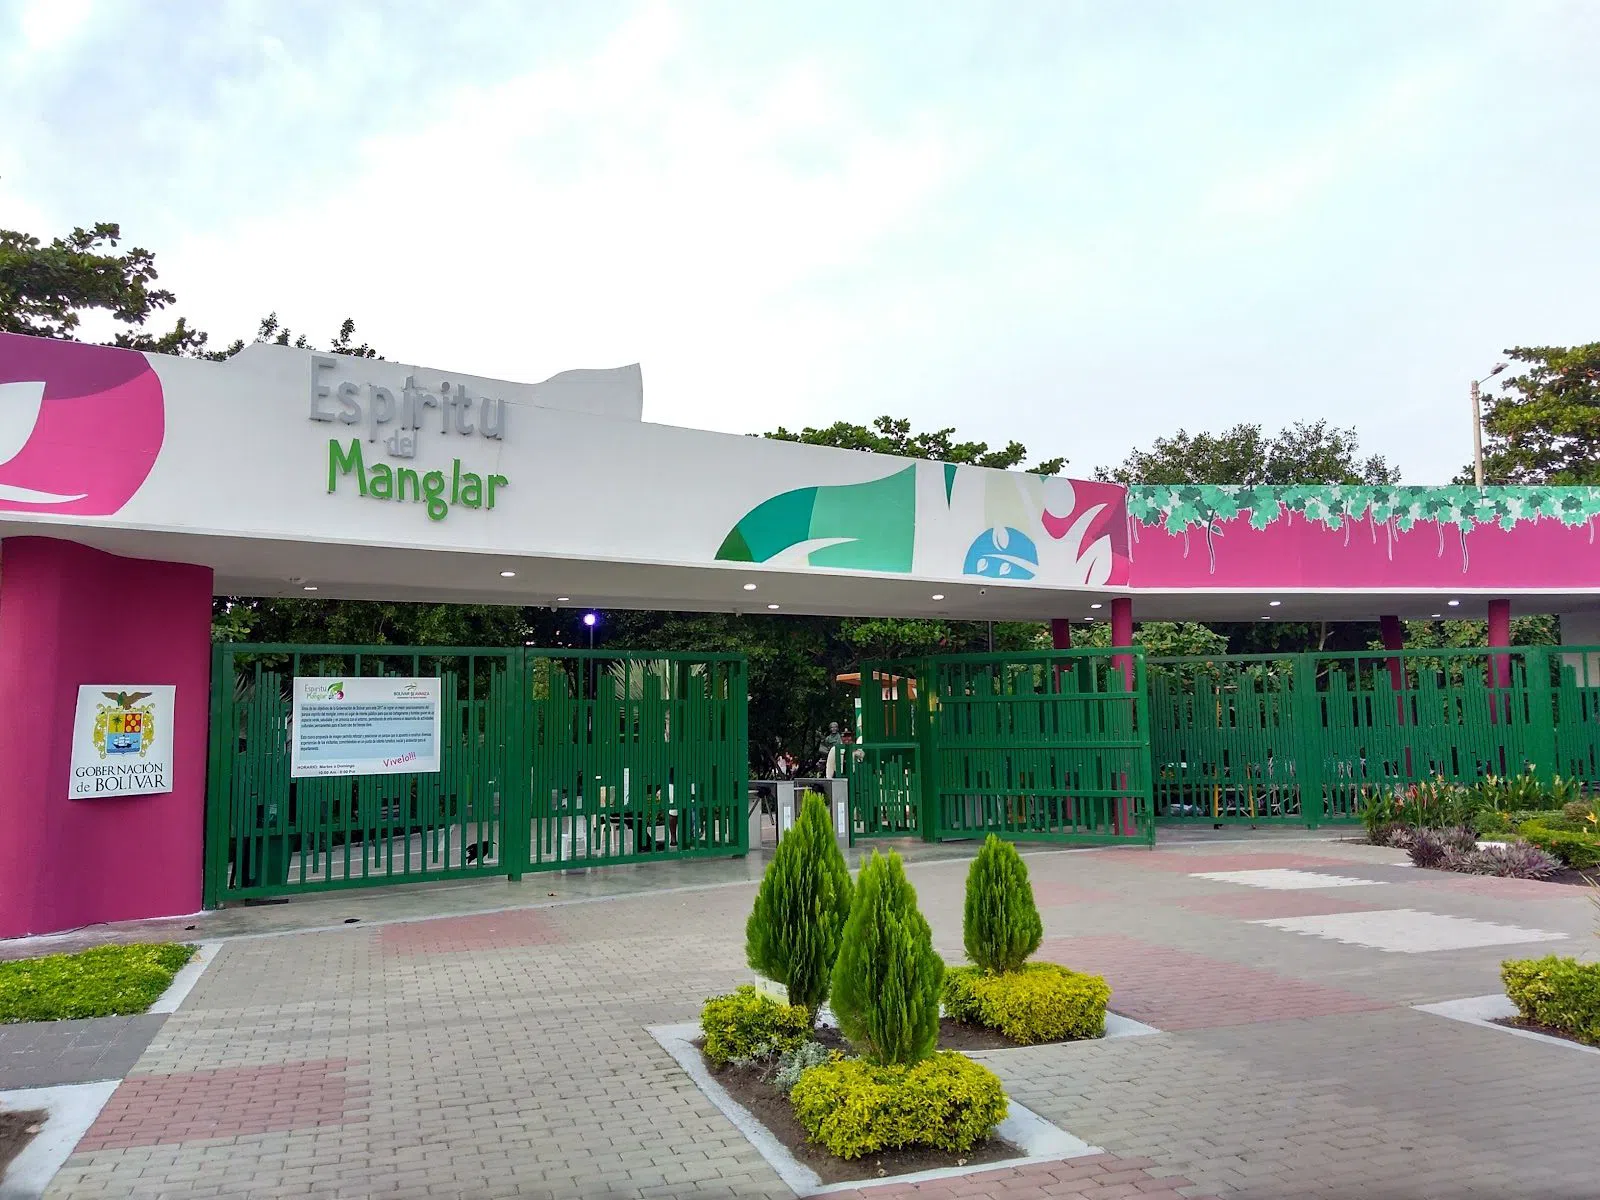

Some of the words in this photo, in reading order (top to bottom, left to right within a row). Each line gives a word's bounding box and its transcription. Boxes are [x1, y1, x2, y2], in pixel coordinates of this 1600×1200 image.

[386, 429, 417, 459] del
[327, 438, 509, 521] Manglar
[75, 762, 163, 778] GOBERNACIÓN
[76, 782, 90, 793] de
[96, 774, 166, 792] BOLÍVAR
